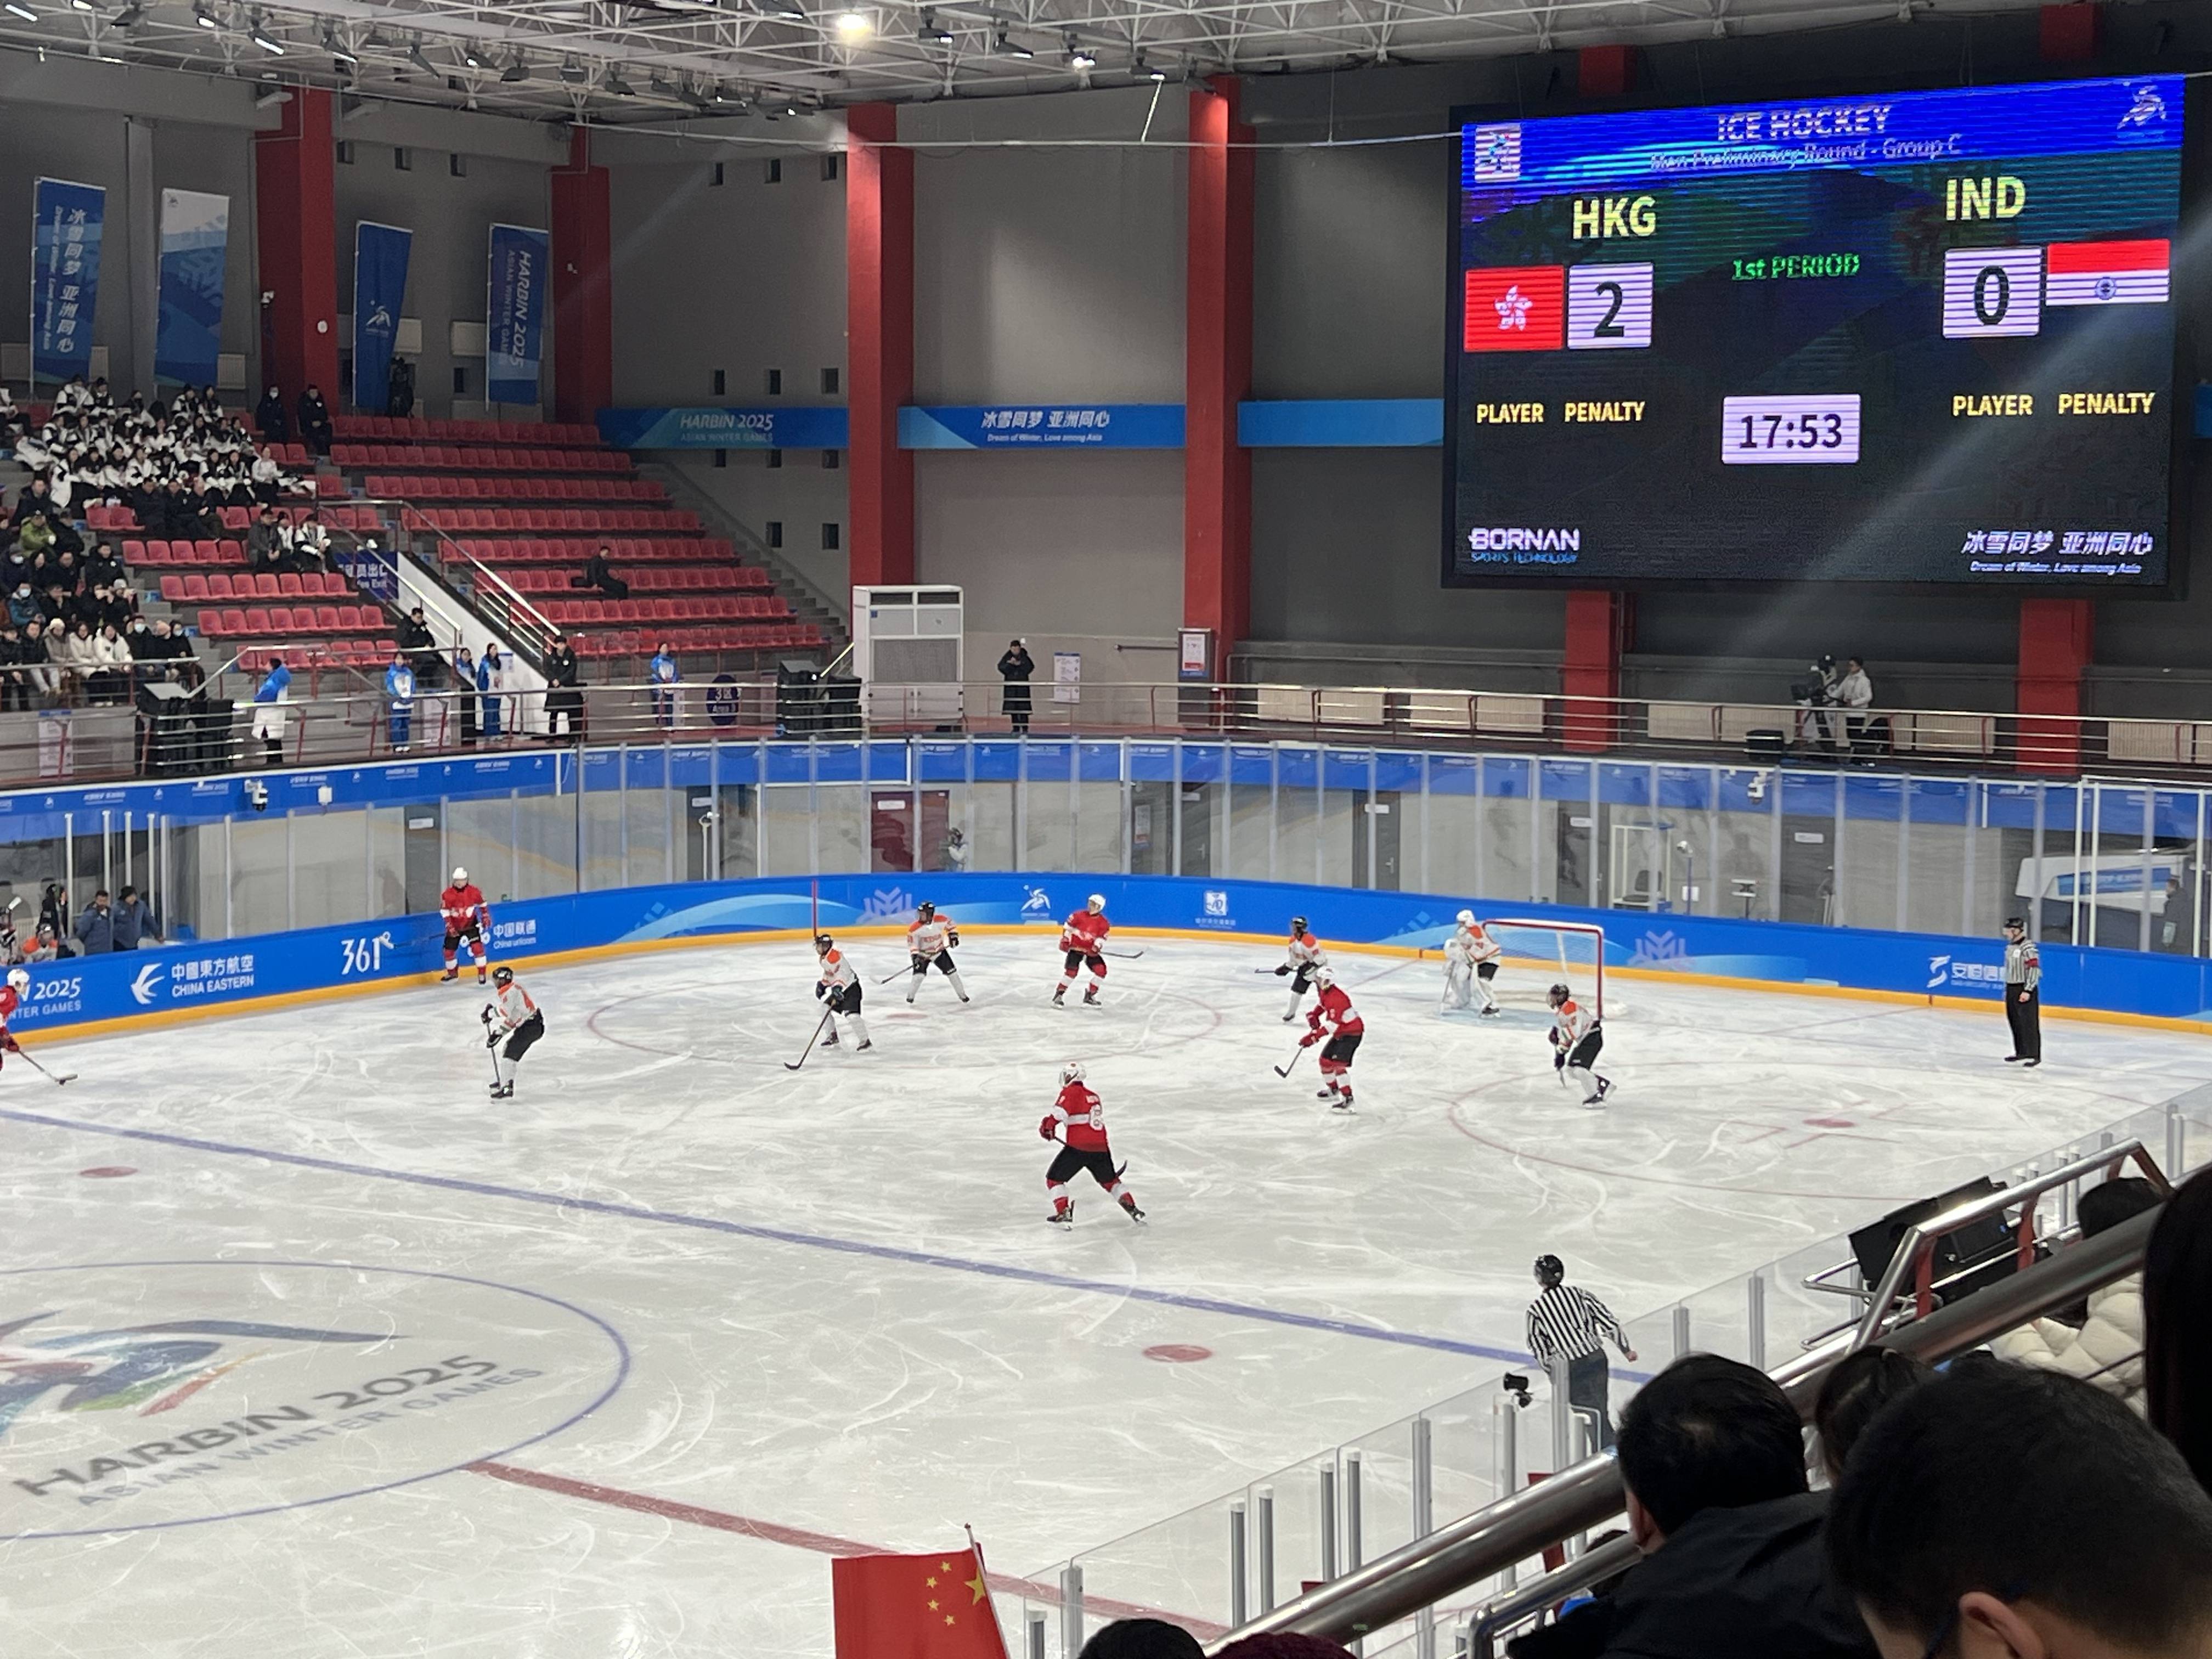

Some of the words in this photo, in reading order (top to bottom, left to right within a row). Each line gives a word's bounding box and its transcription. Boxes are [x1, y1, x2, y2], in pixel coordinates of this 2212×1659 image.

[1718, 111, 1763, 141] ICE
[1770, 104, 1892, 139] HOCKEY
[1804, 140, 1866, 160] Round
[1882, 137, 1942, 160] Group
[1948, 133, 1962, 154] C
[1946, 176, 2026, 221] IND
[1572, 195, 1657, 239] HKG
[1731, 258, 1767, 281] 1st
[1771, 252, 1860, 279] PERIOD
[515, 250, 532, 320] HARBIN
[1974, 265, 2010, 326] 0
[1594, 281, 1625, 338] 2
[509, 321, 527, 368] 2025
[1476, 402, 1544, 424] PLAYER
[1564, 400, 1646, 423] PENALTY
[1952, 394, 2034, 416] PLAYER
[2058, 392, 2156, 415] PENALTY
[680, 414, 735, 429] HARBIN
[737, 414, 775, 431] 2025
[1046, 410, 1110, 428] 亚洲同心
[1739, 413, 1843, 449] 17:53
[1468, 527, 1581, 551] BORNAN
[1960, 530, 2055, 555] 冰雪同梦
[2058, 531, 2154, 556] 亚洲同心
[493, 918, 536, 938] 中国联通
[33, 977, 82, 1000] 2025
[172, 983, 205, 998] CHINA
[207, 974, 255, 993] EASTERN
[42, 1000, 82, 1015] GAMES
[12, 1405, 315, 1497] HARBIN
[313, 1355, 498, 1410] 2025
[77, 1462, 220, 1506] ASIAN
[220, 1410, 405, 1462] WINTER
[401, 1368, 544, 1410] GAMES
